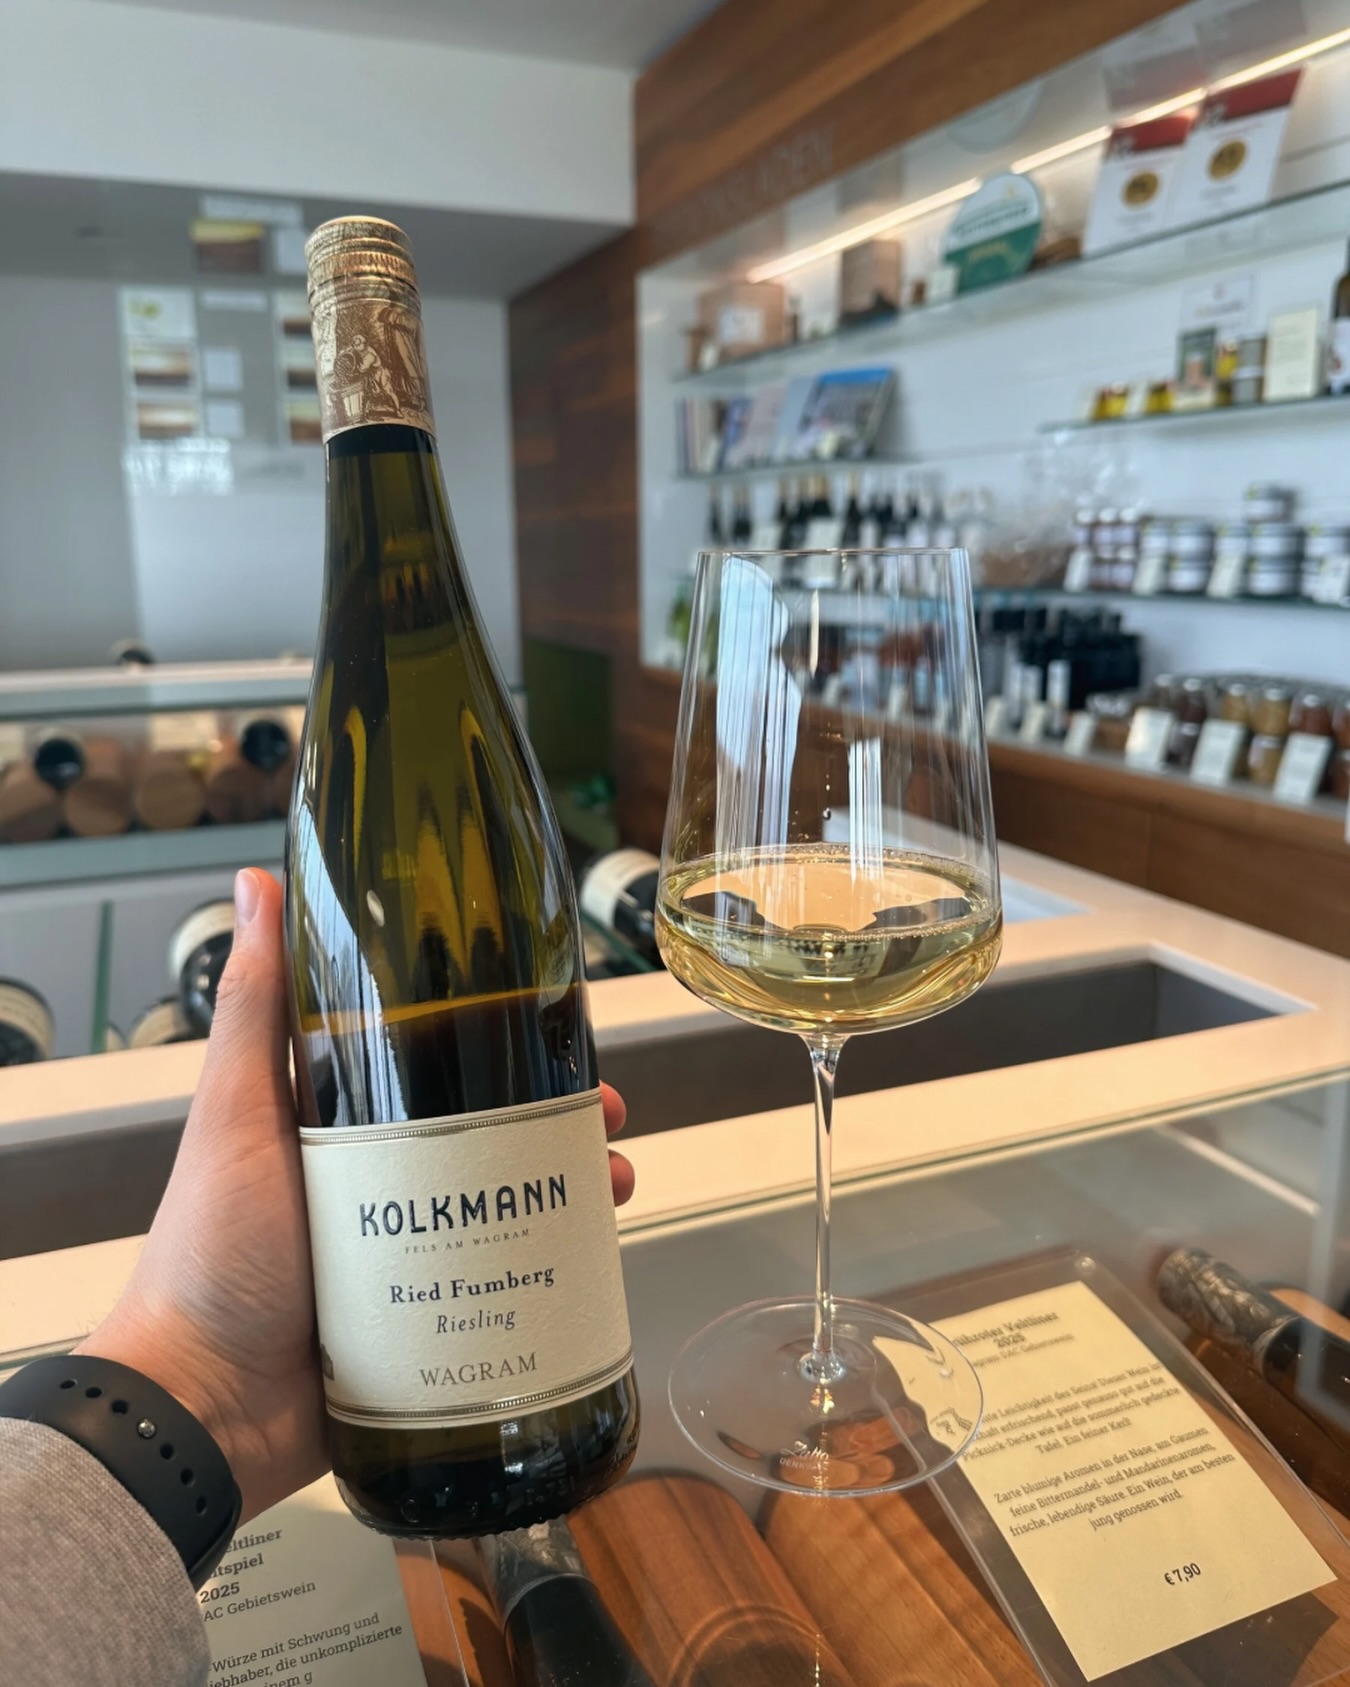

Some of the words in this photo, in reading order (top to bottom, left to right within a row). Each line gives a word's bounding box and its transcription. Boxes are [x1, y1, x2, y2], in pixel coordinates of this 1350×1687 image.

[359, 1174, 567, 1236] KOLKMANN
[405, 1244, 437, 1254] FELS
[445, 1240, 464, 1250] AM
[472, 1228, 530, 1246] WAGRAM
[389, 1282, 442, 1304] Ried
[450, 1267, 555, 1299] Fumberg
[436, 1309, 516, 1334] Riesling
[420, 1352, 537, 1387] WAGRAM
[1037, 1426, 1056, 1436] wie
[1063, 1434, 1083, 1445] Ein
[994, 1488, 1023, 1503] Zarte
[1021, 1475, 1063, 1494] blumige
[1064, 1462, 1103, 1481] Aromen
[1101, 1458, 1114, 1468] in
[1113, 1453, 1130, 1464] der
[1128, 1445, 1157, 1458] Nase,
[1155, 1439, 1173, 1450] am
[1170, 1427, 1210, 1444] Gaumen
[1010, 1502, 1038, 1517] feine
[1036, 1478, 1104, 1508] Bittermandel-
[1104, 1470, 1126, 1485] und
[1122, 1443, 1217, 1478] Mandarinenaromen,
[1009, 1518, 1050, 1536] frische,
[1047, 1501, 1097, 1523] lebendige
[1126, 1484, 1147, 1496] Ein
[1143, 1476, 1174, 1489] Wein,
[1172, 1469, 1189, 1480] der
[1188, 1464, 1206, 1474] am
[1201, 1454, 1236, 1469] besten
[1089, 1514, 1115, 1531] jung
[1113, 1498, 1160, 1522] genossen
[1158, 1488, 1183, 1503] wird.
[225, 1529, 283, 1553] eltliner
[212, 1552, 264, 1578] tspiel
[1164, 1572, 1175, 1585] €
[1172, 1563, 1201, 1582] 7,90
[200, 1581, 240, 1604] 2025
[204, 1607, 224, 1622] AC
[227, 1582, 316, 1615] Gebietswein
[208, 1652, 257, 1673] -Würze
[261, 1642, 285, 1659] mit
[288, 1622, 351, 1650] Schwung
[353, 1612, 380, 1630] und
[209, 1666, 273, 1687] iebhaber,
[276, 1657, 297, 1672] die
[300, 1624, 403, 1664] unkomplizierte
